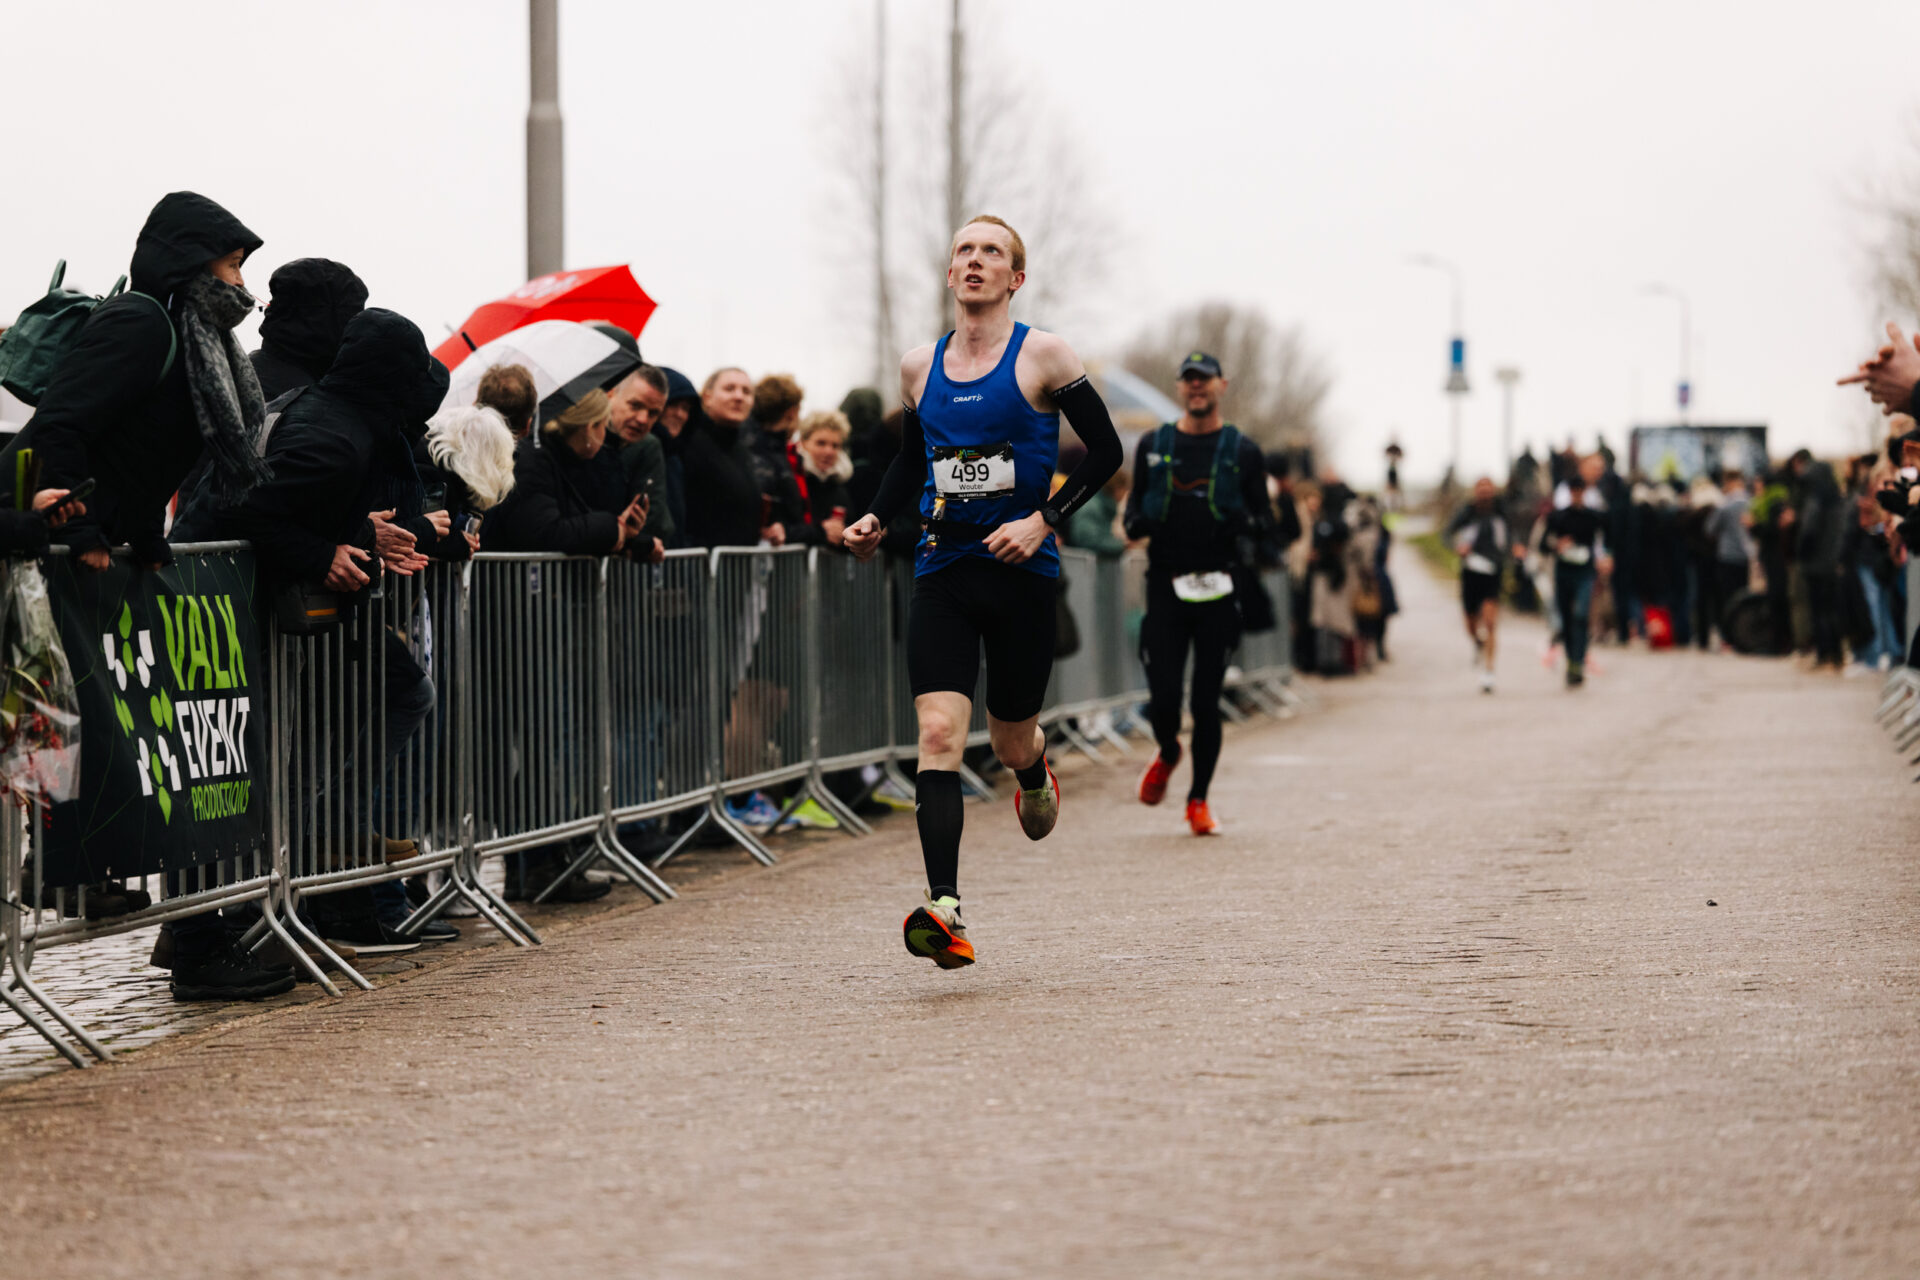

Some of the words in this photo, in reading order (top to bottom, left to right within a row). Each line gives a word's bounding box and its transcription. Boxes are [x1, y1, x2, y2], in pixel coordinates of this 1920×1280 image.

[953, 395, 977, 403] CRAFT
[951, 463, 990, 482] 499
[958, 483, 984, 491] Wouter
[157, 595, 248, 691] VALK
[175, 697, 251, 779] EVENT
[191, 780, 251, 822] PRODUCTIONS
